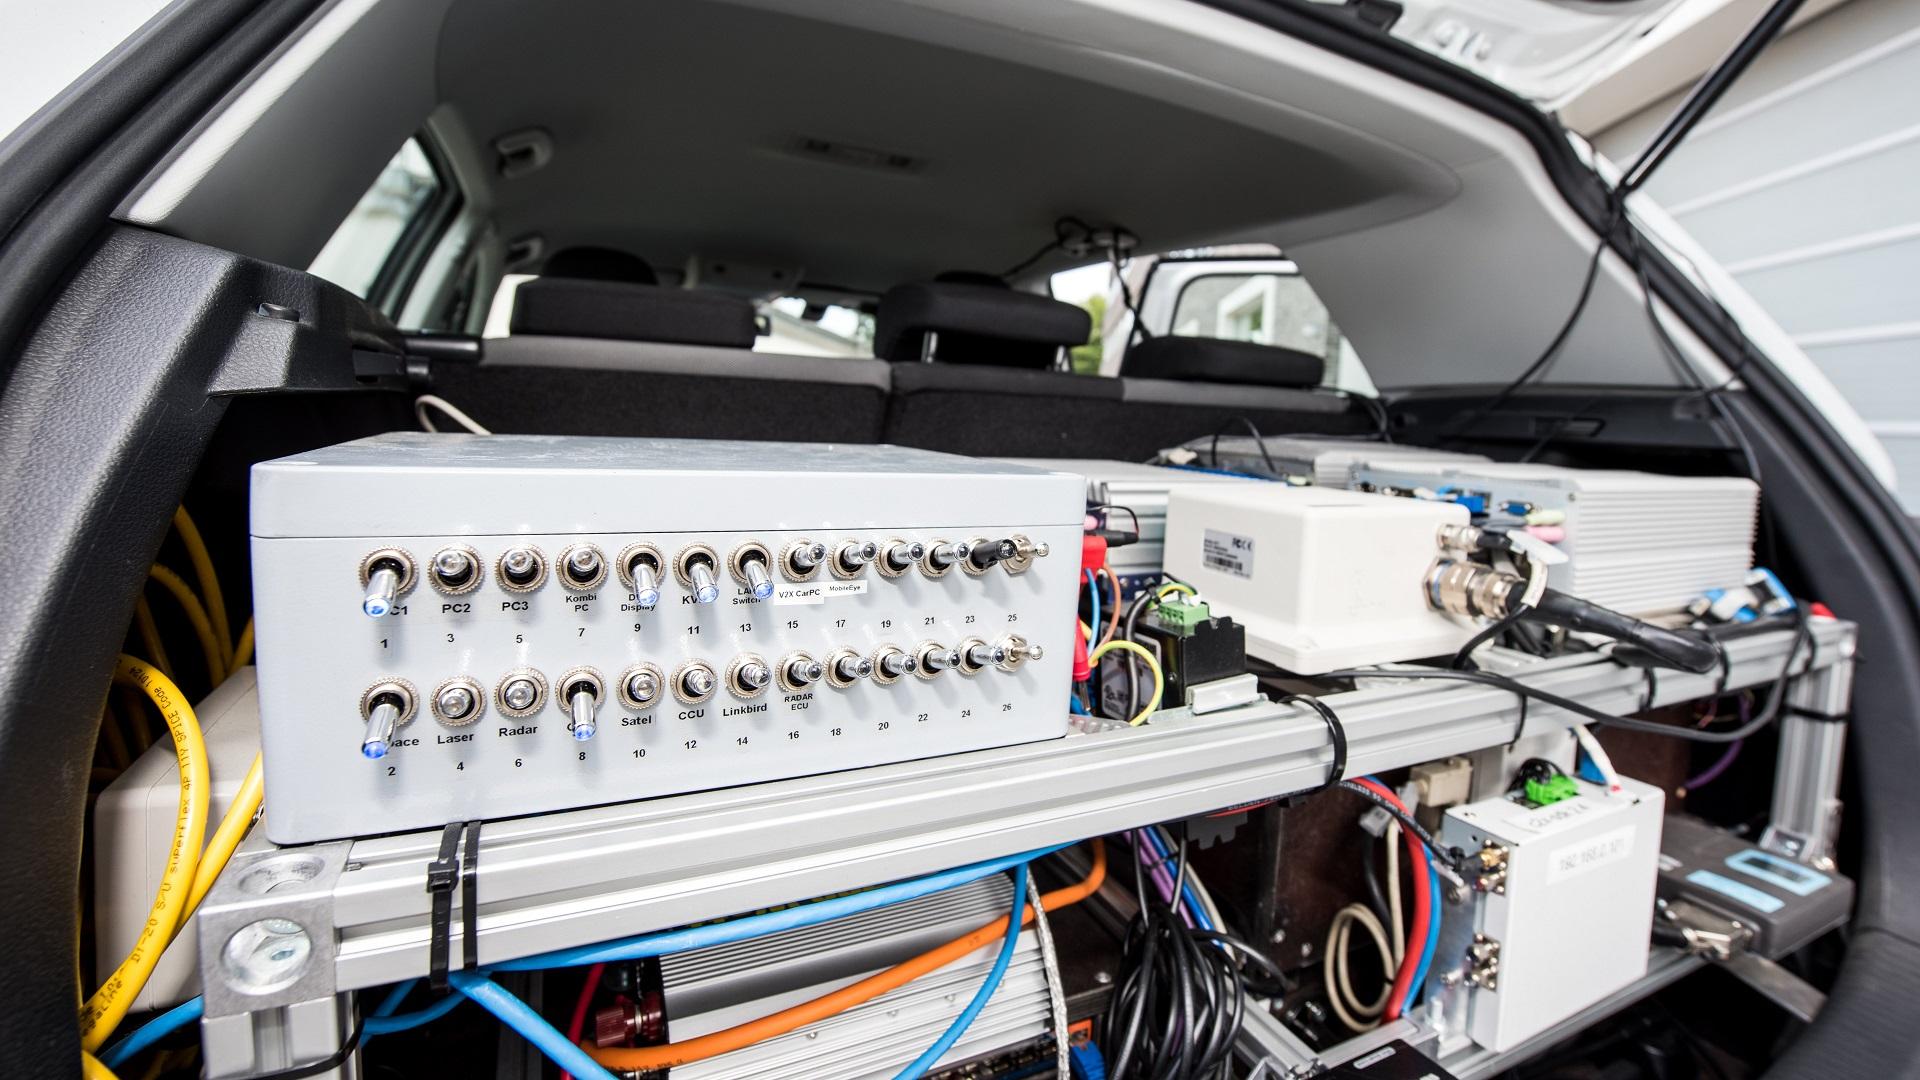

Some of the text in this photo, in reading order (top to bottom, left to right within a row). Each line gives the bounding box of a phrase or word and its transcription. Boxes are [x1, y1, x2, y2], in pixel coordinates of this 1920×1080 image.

[829, 584, 861, 592] MobileEye
[796, 589, 820, 597] CarPC
[565, 593, 597, 603] Kombi
[682, 595, 701, 604] KV
[390, 605, 408, 615] C1
[442, 603, 471, 613] PC2
[502, 601, 529, 611] PC3
[575, 604, 589, 612] PC
[924, 617, 935, 625] 21
[965, 615, 975, 624] 23
[1007, 613, 1017, 622] 25
[634, 623, 641, 632] 9
[739, 623, 752, 632] 13
[787, 620, 799, 629] 15
[836, 619, 846, 628] 17
[881, 620, 891, 629] 19
[578, 628, 586, 637] 7
[688, 626, 700, 635] 11
[447, 633, 455, 643] 3
[516, 634, 523, 643] 5
[380, 638, 388, 648] 1
[784, 693, 813, 703] RADAR
[722, 703, 767, 717] Linkbird
[791, 703, 809, 711] ECU
[1002, 703, 1011, 711] 26
[678, 709, 705, 721] CCU
[918, 713, 928, 722] 22
[961, 709, 971, 717] 24
[621, 715, 652, 727] Satel
[168, 710, 187, 743] SPICE
[498, 724, 538, 737] Radar
[878, 722, 889, 730] 20
[788, 730, 800, 739] 16
[830, 728, 841, 736] 18
[437, 732, 474, 745] Laser
[736, 736, 748, 745] 14
[684, 740, 697, 749] 12
[579, 751, 586, 761] 8
[633, 749, 646, 758] 10
[456, 762, 465, 771] 4
[515, 758, 522, 768] 6
[387, 766, 396, 776] 2
